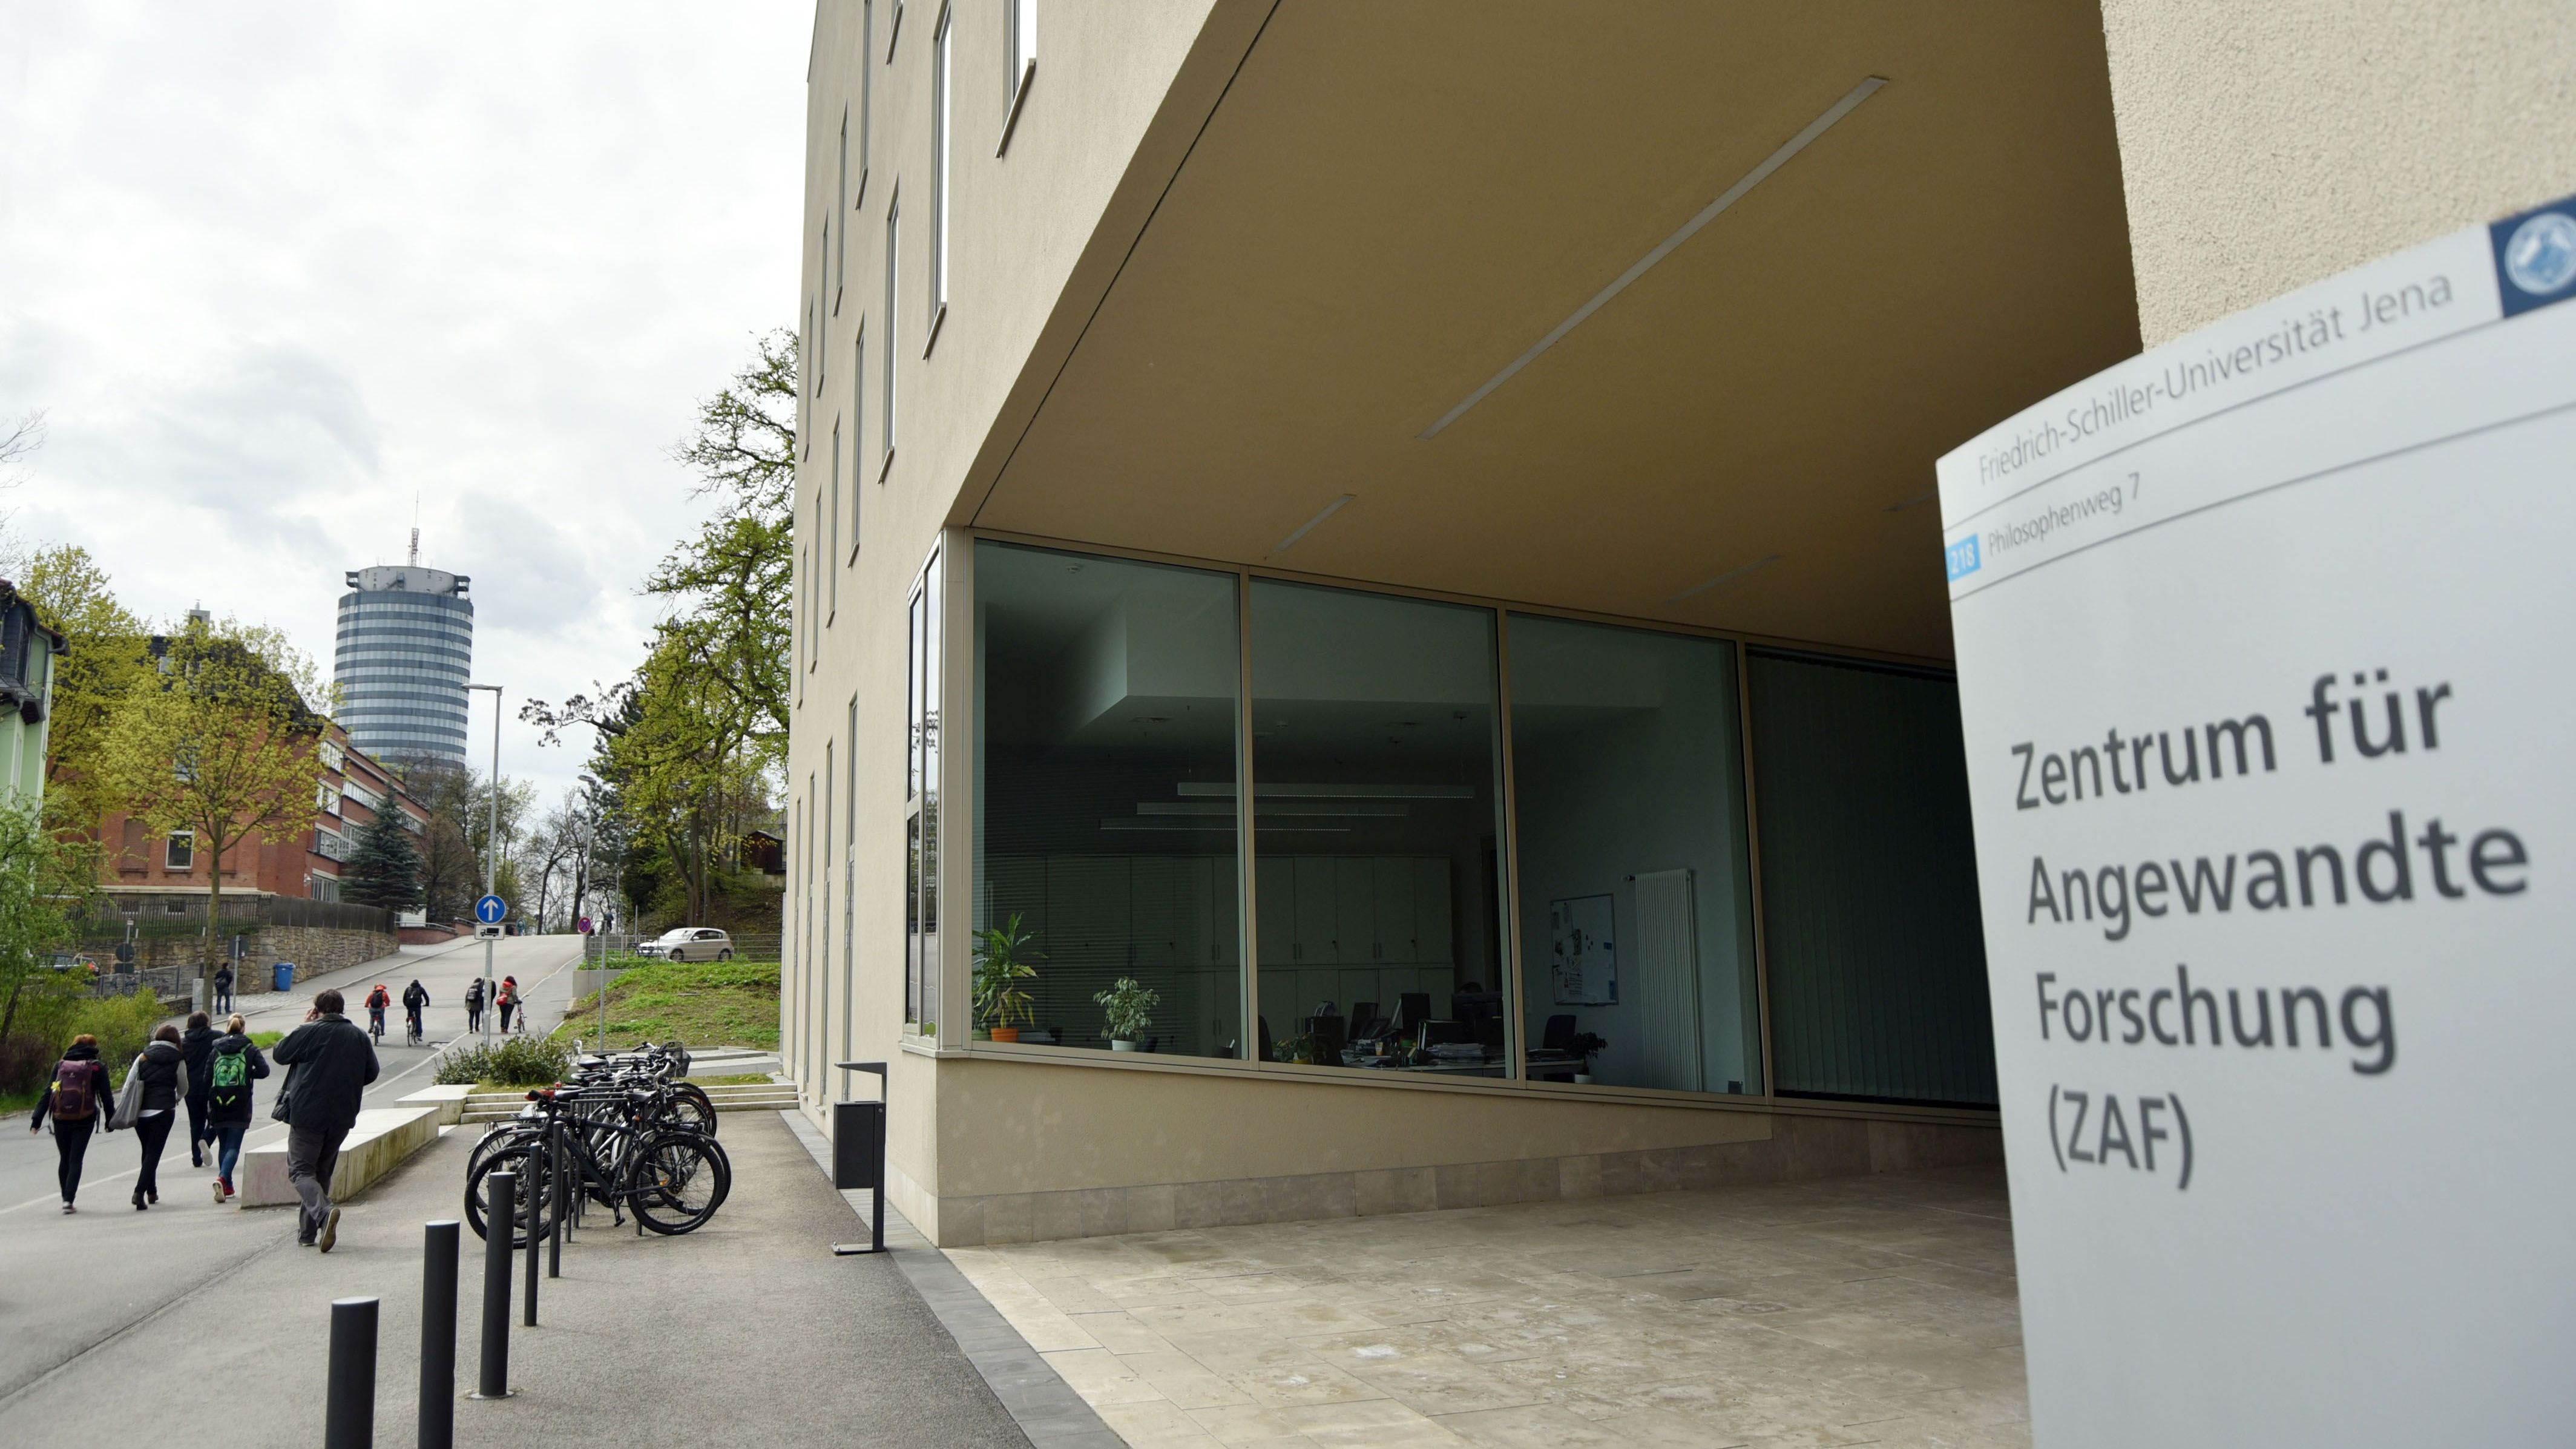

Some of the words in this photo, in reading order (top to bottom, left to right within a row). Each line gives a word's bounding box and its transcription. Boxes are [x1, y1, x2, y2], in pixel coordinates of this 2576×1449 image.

[1978, 306, 2346, 486] Friedrich-Schiller-Universität
[2358, 273, 2454, 332] Jena
[1950, 543, 1976, 575] 218
[1988, 485, 2123, 556] Philosophenweg
[2127, 471, 2140, 500] 7
[2011, 712, 2278, 812] Zentrum
[2303, 666, 2454, 766] für
[2027, 808, 2532, 944] Angewandte
[2035, 962, 2399, 1079] Forschung
[2048, 1083, 2195, 1194] (ZAF)
